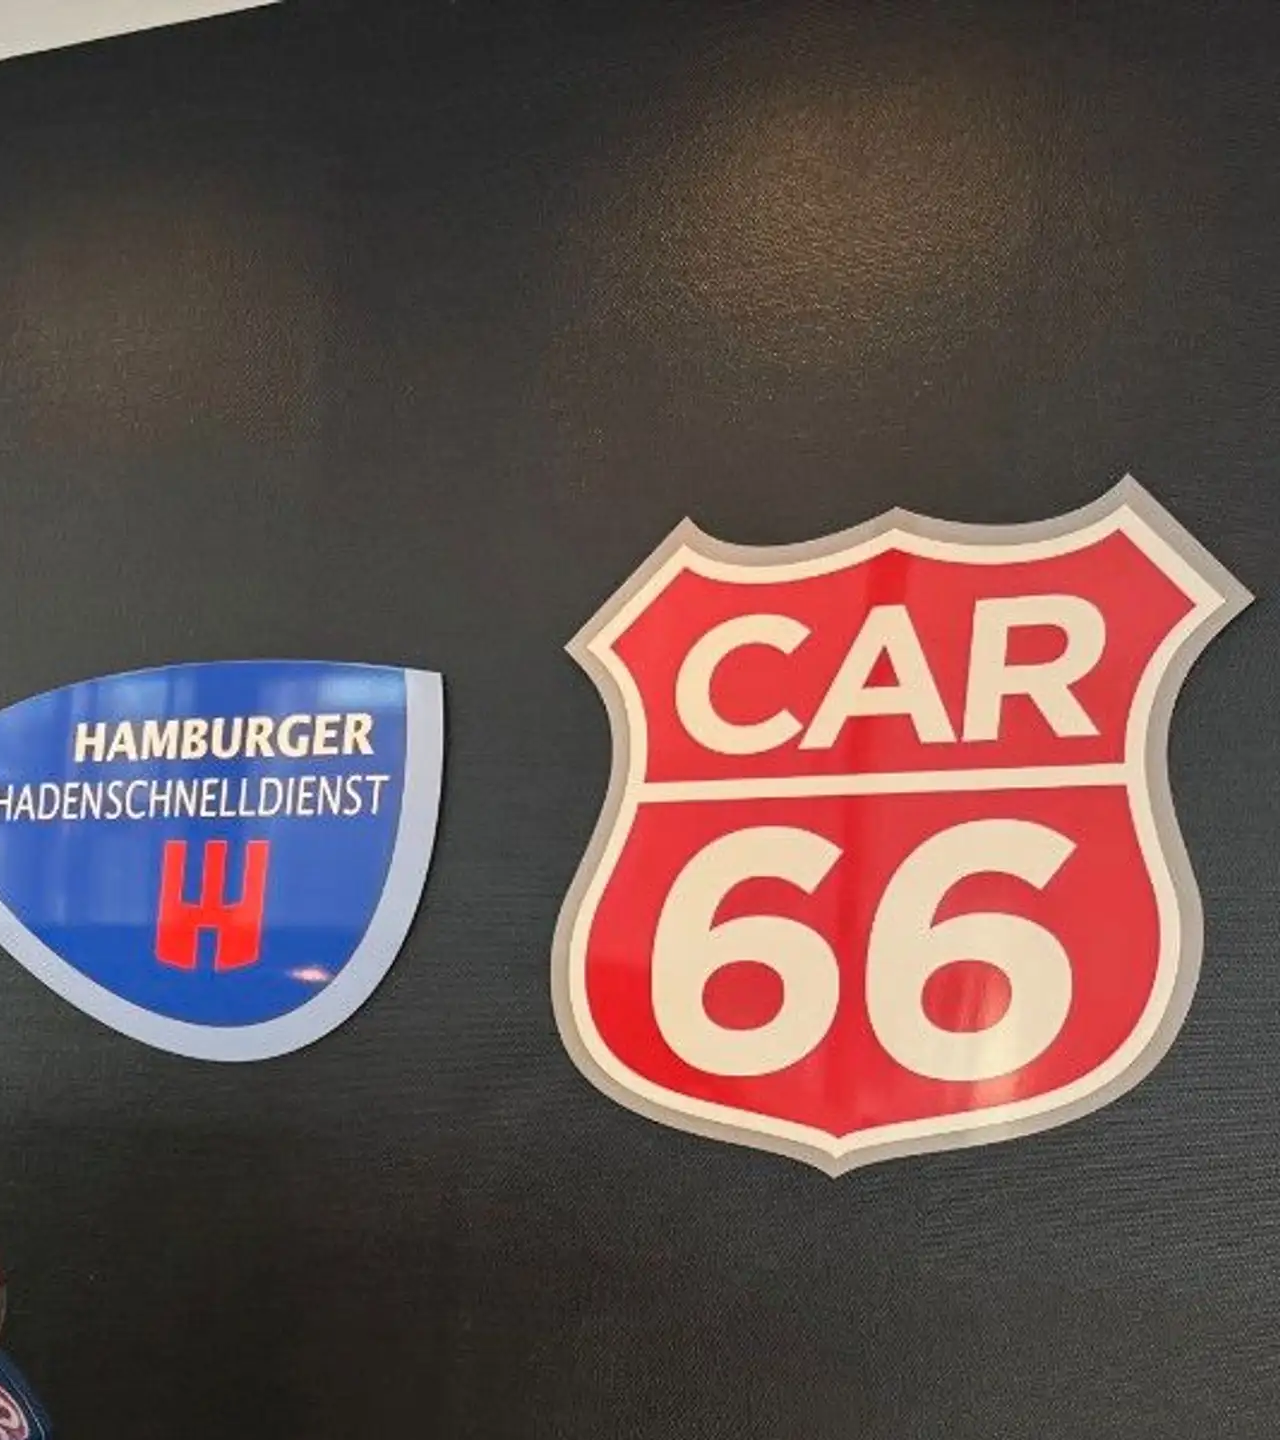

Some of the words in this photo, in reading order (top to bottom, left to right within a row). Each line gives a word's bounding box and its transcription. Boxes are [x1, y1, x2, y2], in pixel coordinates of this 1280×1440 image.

[73, 713, 375, 763] HAMBURGER
[675, 593, 1107, 756] CAR
[650, 817, 1078, 1082] 66
